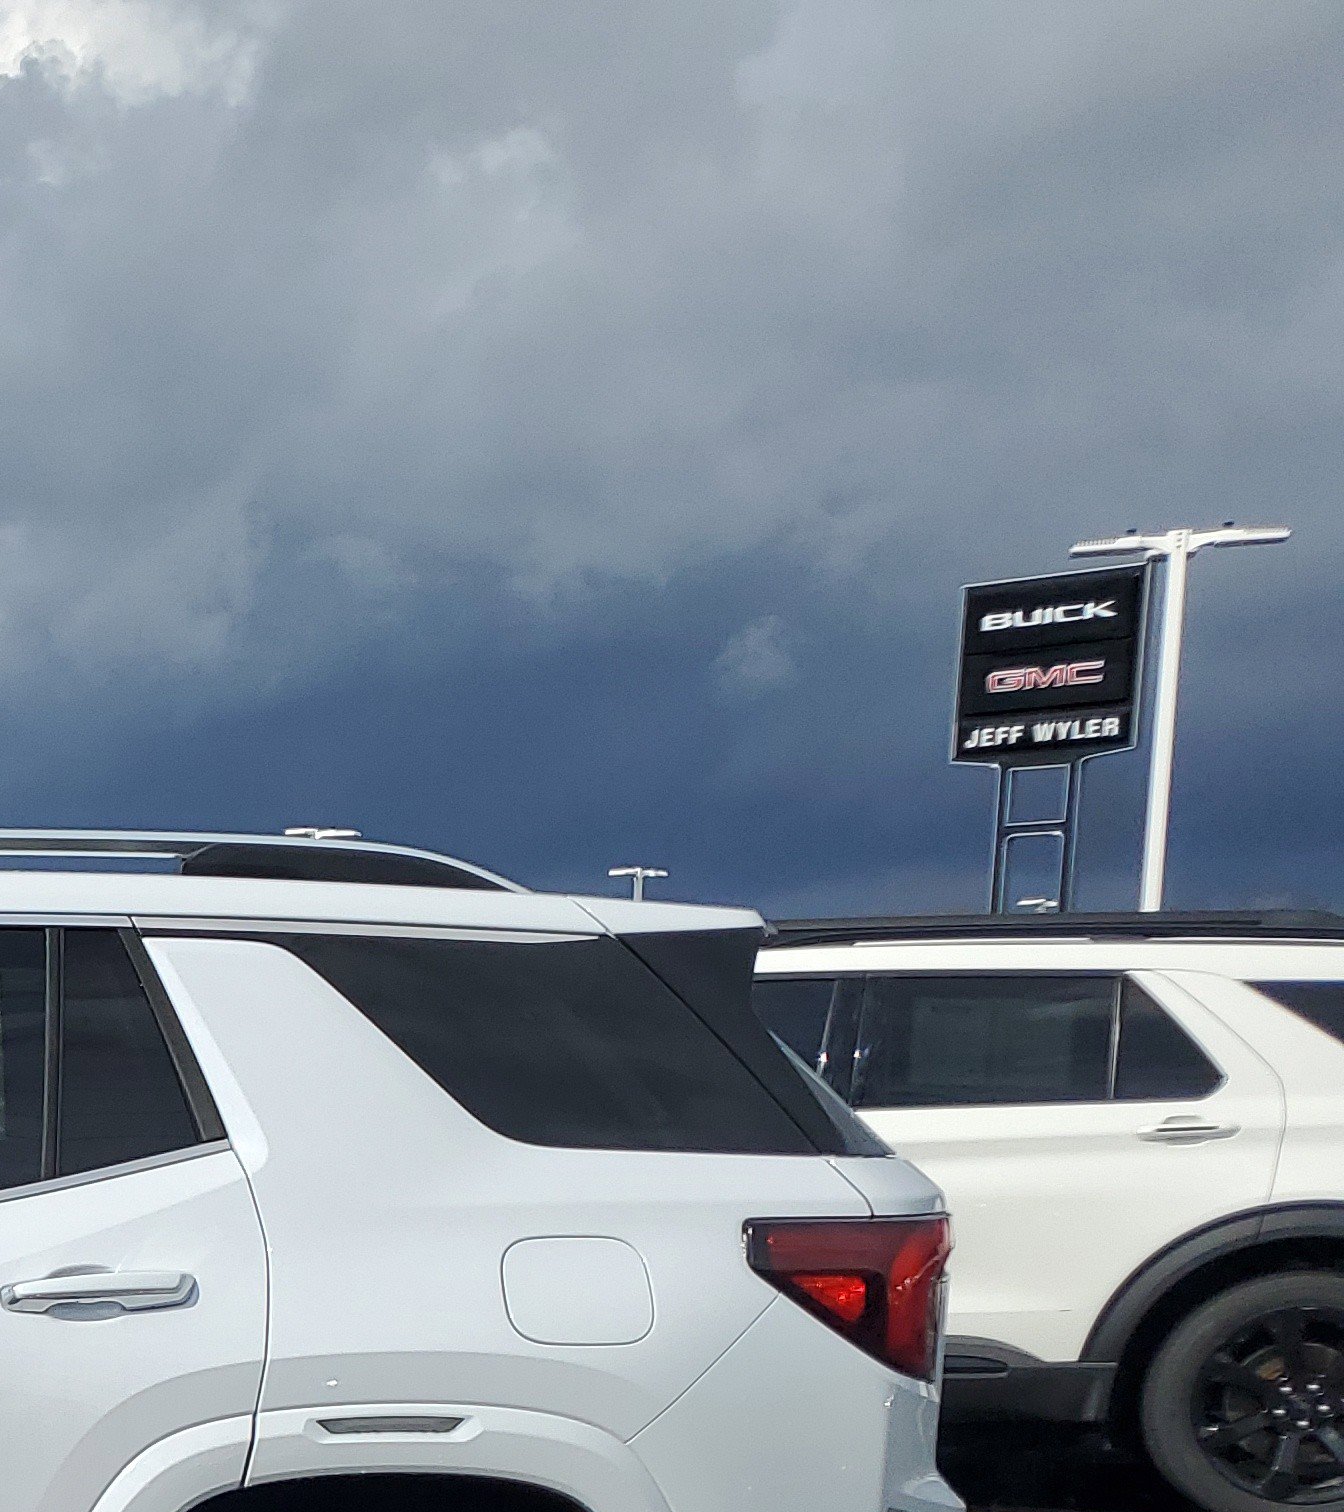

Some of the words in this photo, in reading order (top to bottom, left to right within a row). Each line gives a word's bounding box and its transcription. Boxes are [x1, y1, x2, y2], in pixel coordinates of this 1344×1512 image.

[980, 600, 1118, 632] BUICK
[986, 659, 1105, 694] GMC
[964, 725, 1025, 749] JEFF
[1031, 717, 1120, 743] WYLER
